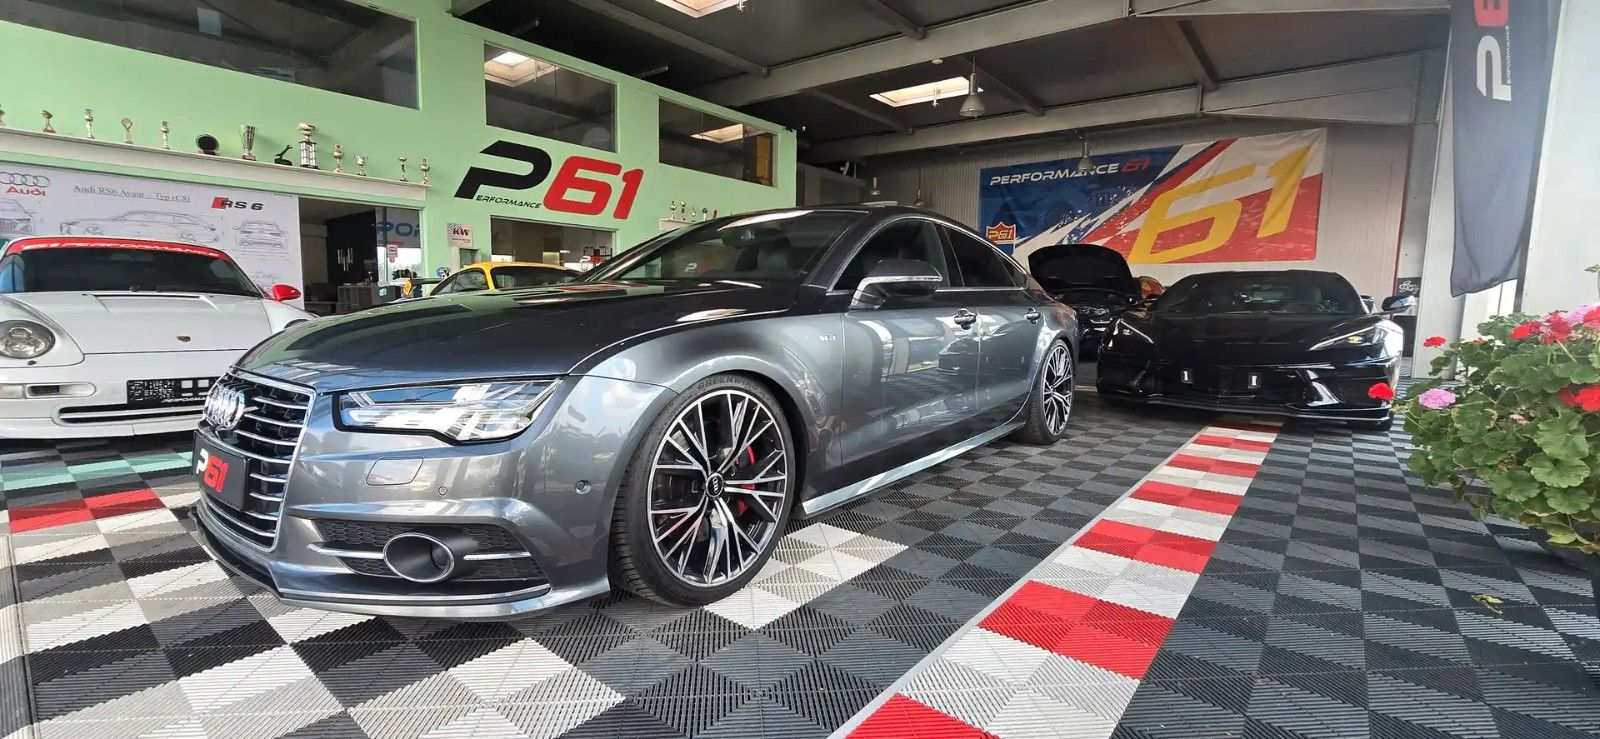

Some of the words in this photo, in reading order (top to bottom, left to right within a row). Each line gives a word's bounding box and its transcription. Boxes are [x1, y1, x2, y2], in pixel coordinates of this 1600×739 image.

[990, 162, 1120, 186] PERFORMANCE
[1120, 156, 1152, 173] 61
[453, 139, 645, 220] P61
[5, 186, 46, 197] Audi
[73, 185, 96, 194] Audi
[120, 189, 145, 198] Avant
[221, 199, 248, 210] RS
[250, 203, 264, 211] 6
[475, 194, 543, 209] ERFORMANCE
[1126, 143, 1314, 265] 61
[453, 226, 470, 236] KW
[987, 228, 1014, 240] P61
[195, 448, 229, 493] P61
